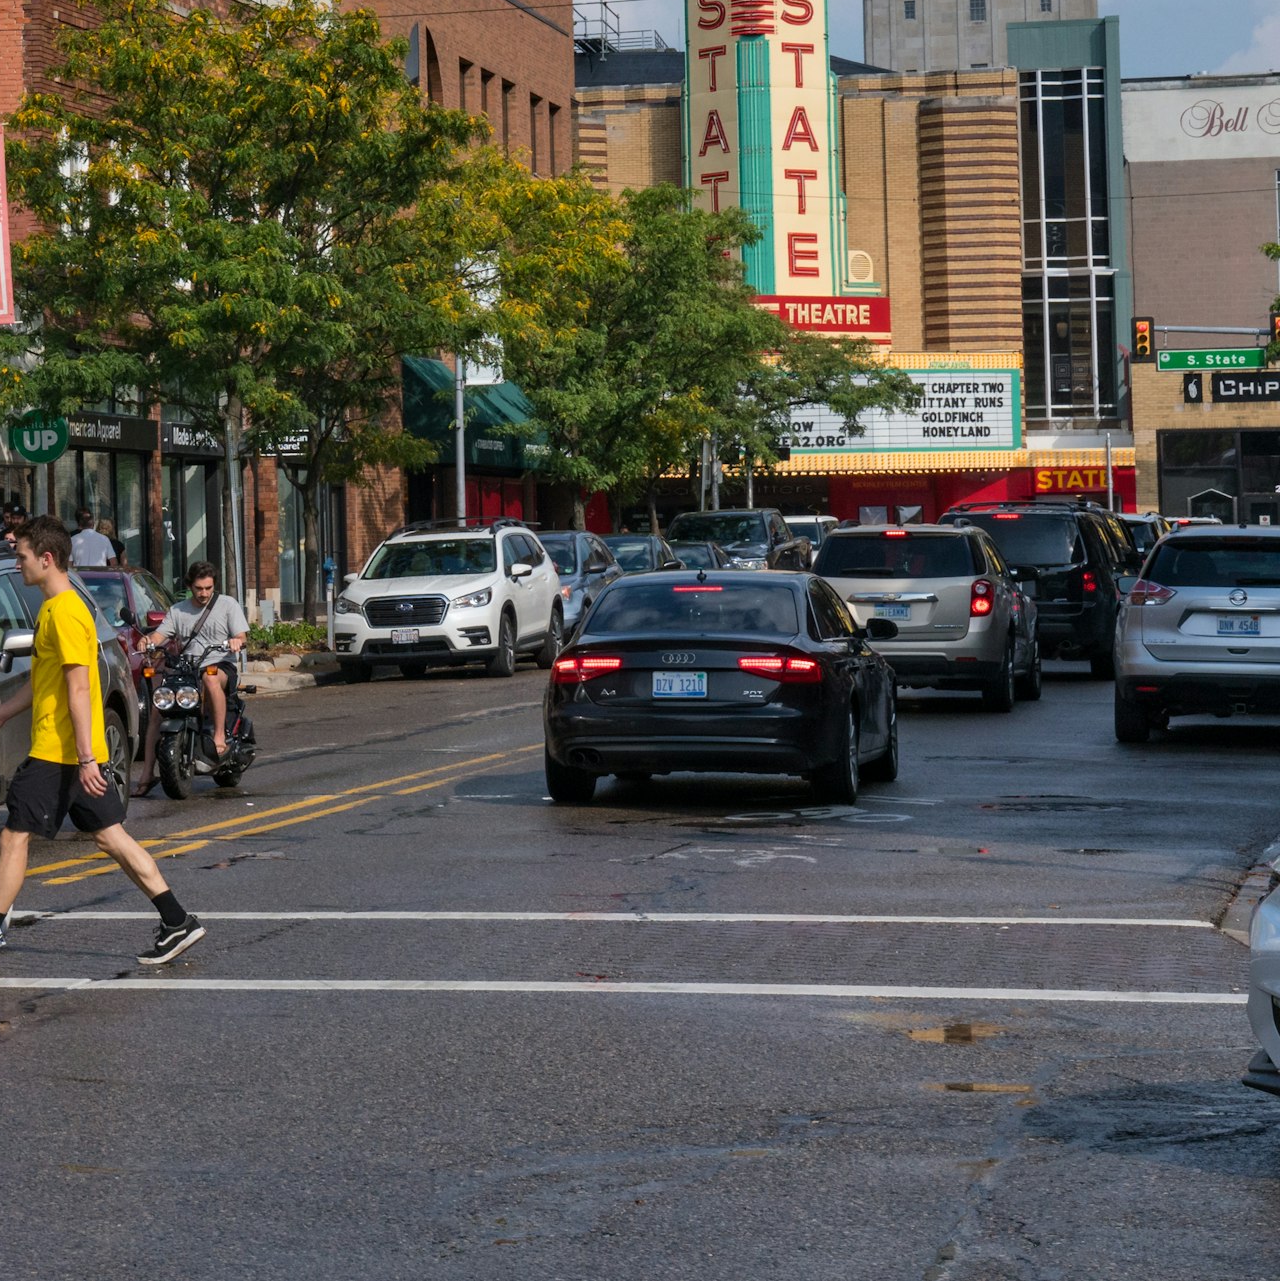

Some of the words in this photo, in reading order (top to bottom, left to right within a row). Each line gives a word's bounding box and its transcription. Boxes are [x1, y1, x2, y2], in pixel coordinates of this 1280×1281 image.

[1180, 99, 1249, 138] Bell
[785, 302, 870, 325] THEATRE
[1187, 354, 1200, 366] S.
[1205, 354, 1246, 365] State
[931, 382, 979, 394] CHAPTER
[981, 382, 1004, 394] TWO
[974, 397, 1004, 409] RUNS
[921, 411, 983, 423] GOLDFINCH
[922, 426, 991, 438] HONEYLAND
[22, 429, 59, 452] UP
[656, 678, 673, 692] DZV
[679, 678, 704, 692] 1210
